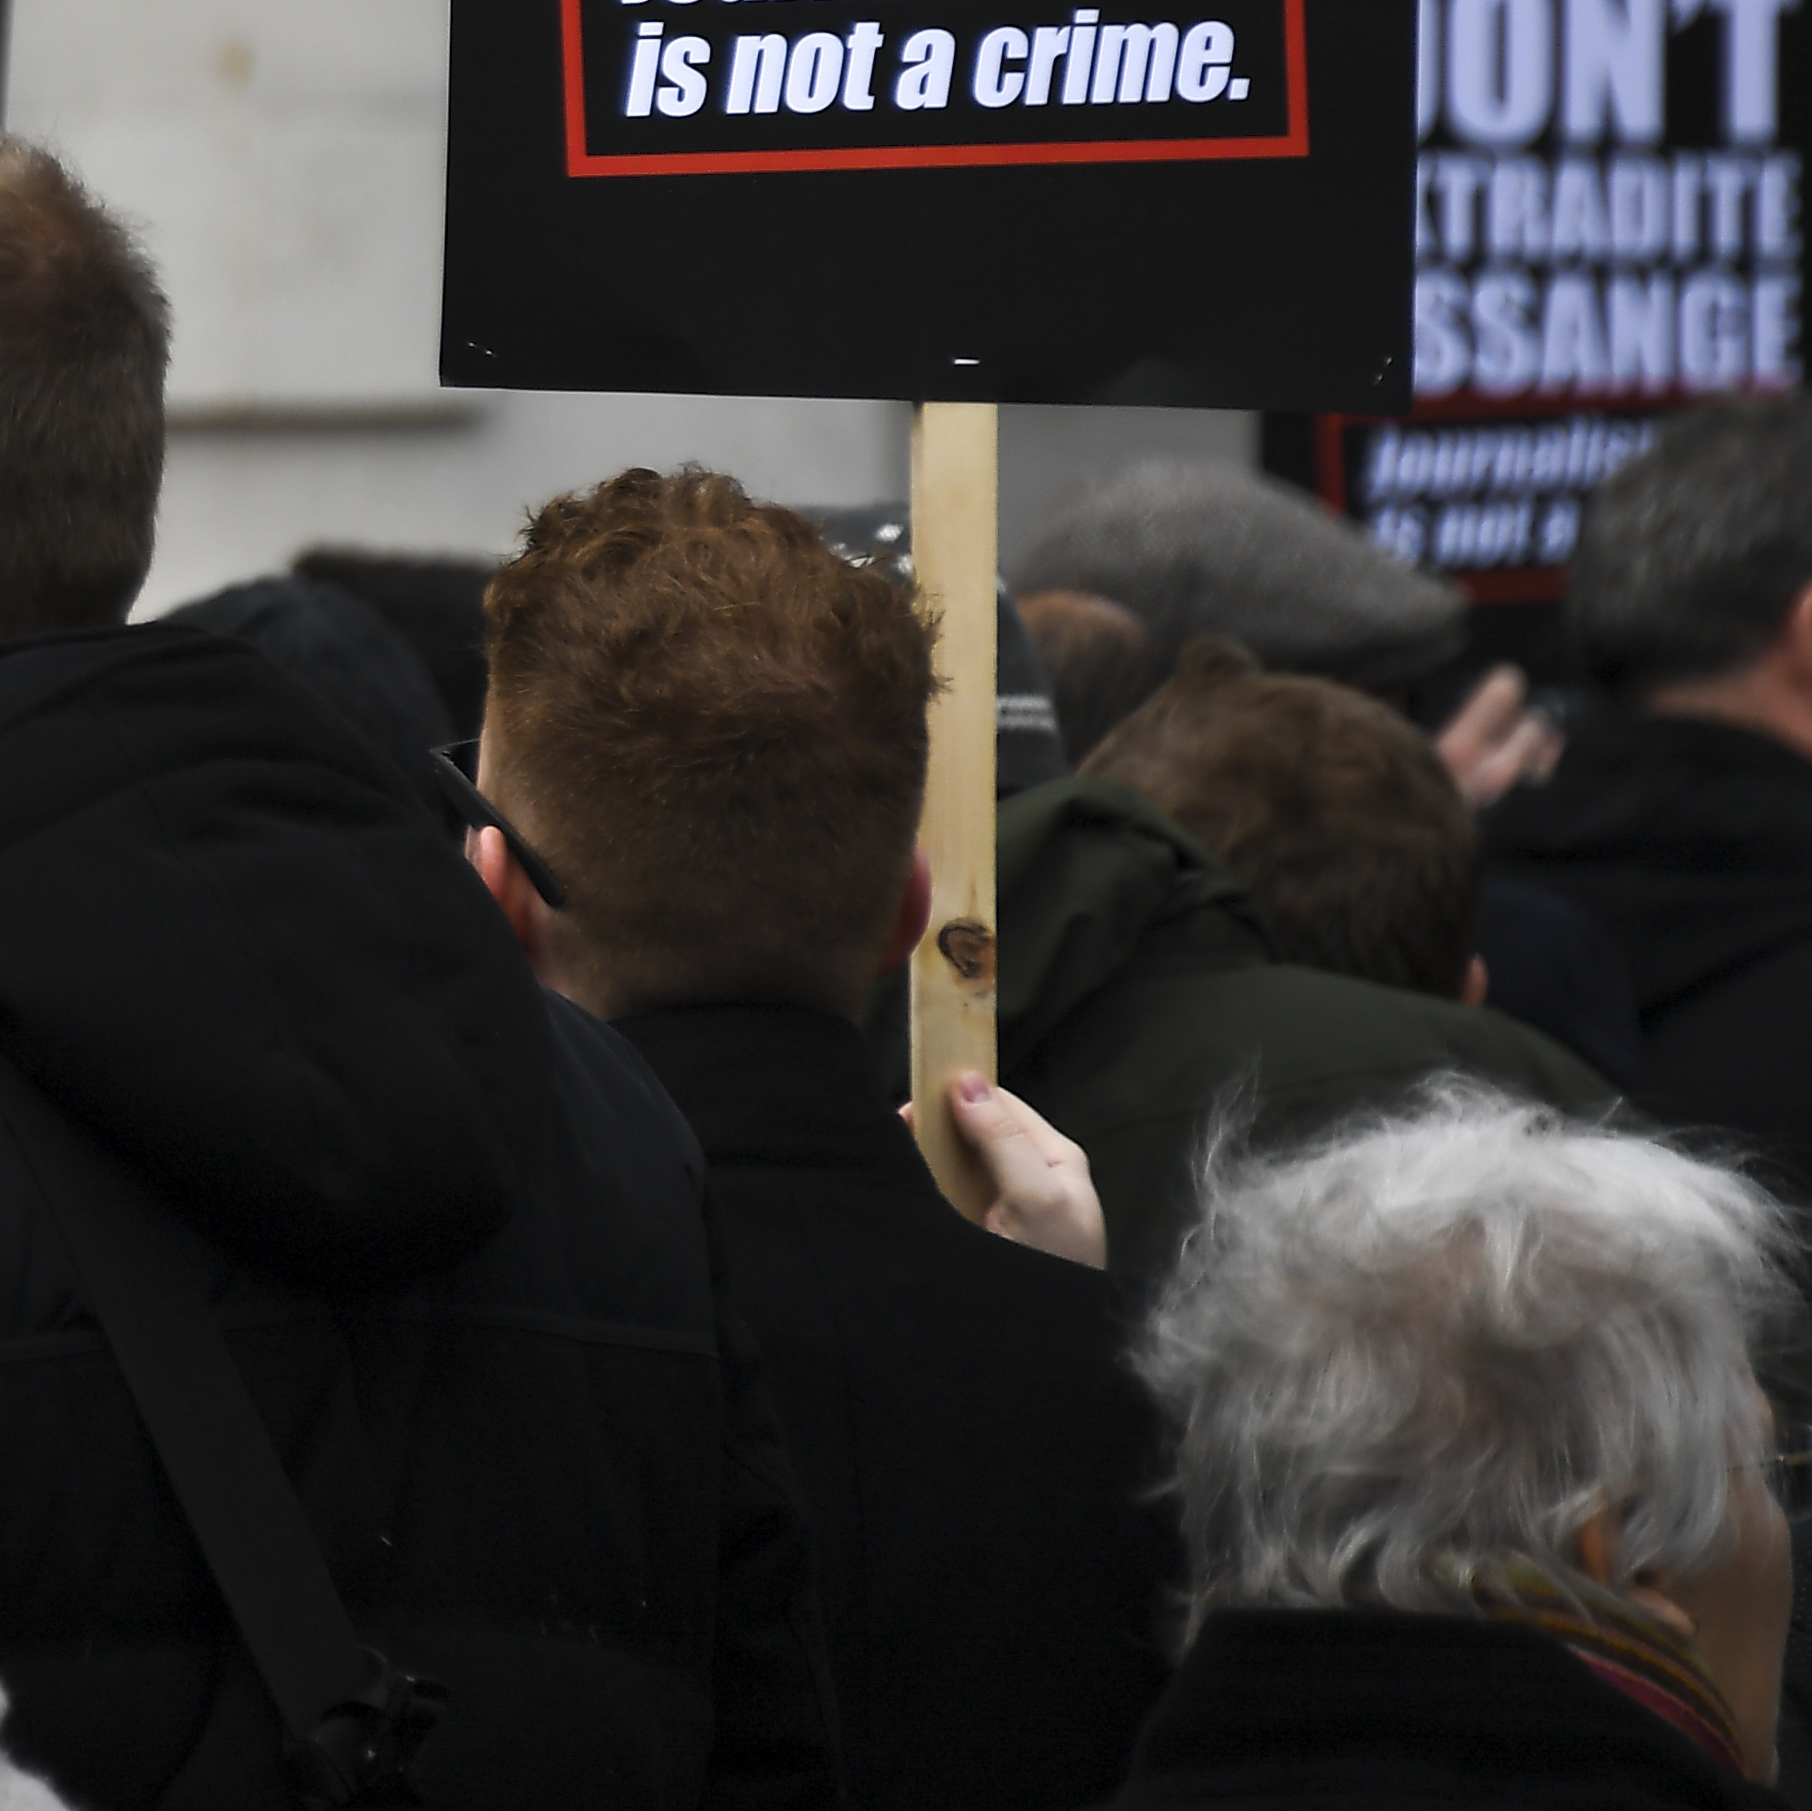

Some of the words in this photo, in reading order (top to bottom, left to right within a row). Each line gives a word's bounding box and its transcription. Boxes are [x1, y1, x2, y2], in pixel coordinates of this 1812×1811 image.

[626, 22, 710, 117] is
[726, 22, 883, 114] not
[895, 29, 955, 109] a
[974, 10, 1249, 107] crime.
[1417, 150, 1803, 266] TRADITE
[1414, 268, 1805, 394] SSANGE
